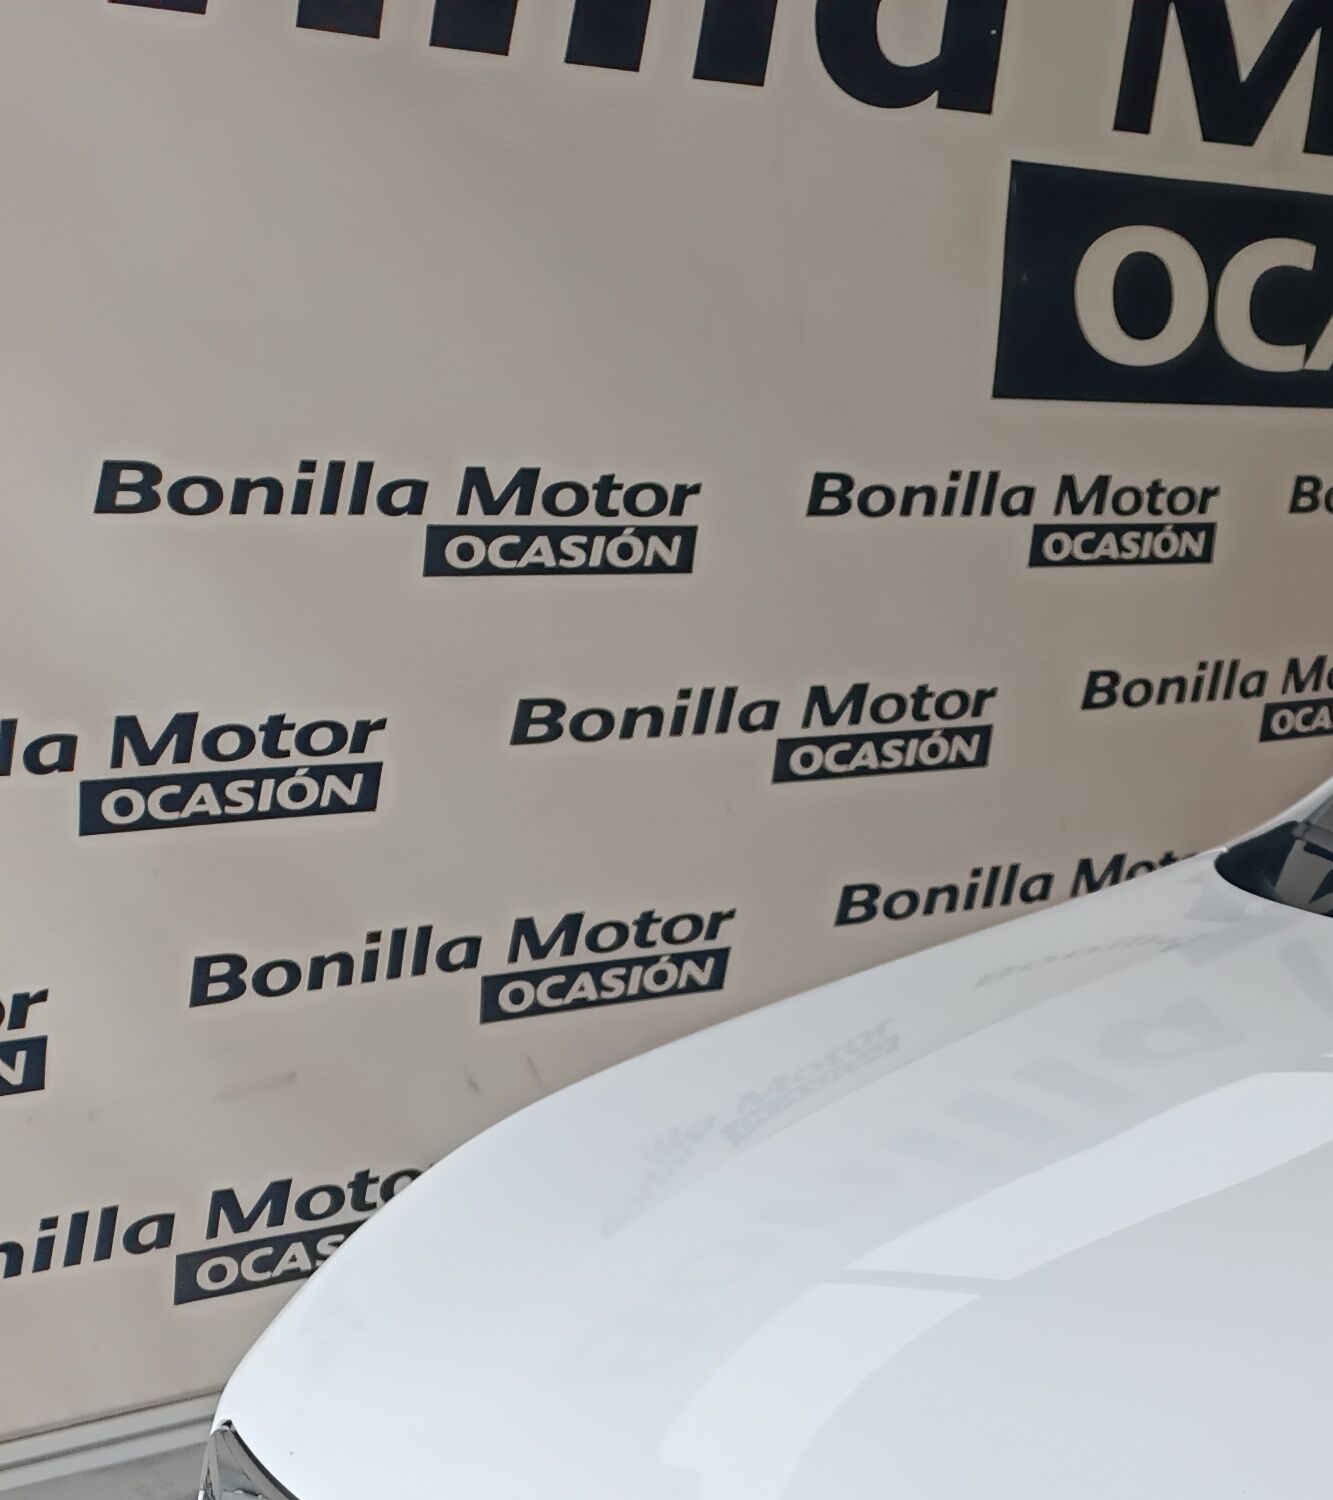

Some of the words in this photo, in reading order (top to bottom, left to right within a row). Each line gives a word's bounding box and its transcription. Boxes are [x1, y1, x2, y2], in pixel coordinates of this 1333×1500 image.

[93, 459, 429, 516] Bonilla
[457, 466, 702, 518] Motor
[806, 470, 1035, 518] Bonilla
[1053, 473, 1220, 517] Motor
[444, 529, 682, 570] OCASIÓN
[1042, 525, 1206, 561] OCASIÓN
[1081, 659, 1268, 711] Bonilla
[110, 711, 388, 769] Motor
[509, 686, 780, 746] Bonilla
[801, 682, 998, 728] Motor
[789, 730, 980, 776] OCASIÓN
[101, 769, 364, 825] OCASIÓN
[834, 863, 1054, 927] Bonilla
[189, 925, 483, 1008] Bonilla
[508, 907, 736, 964] Motor
[497, 956, 716, 1013] OCASIÓN
[206, 1163, 440, 1240] Moto
